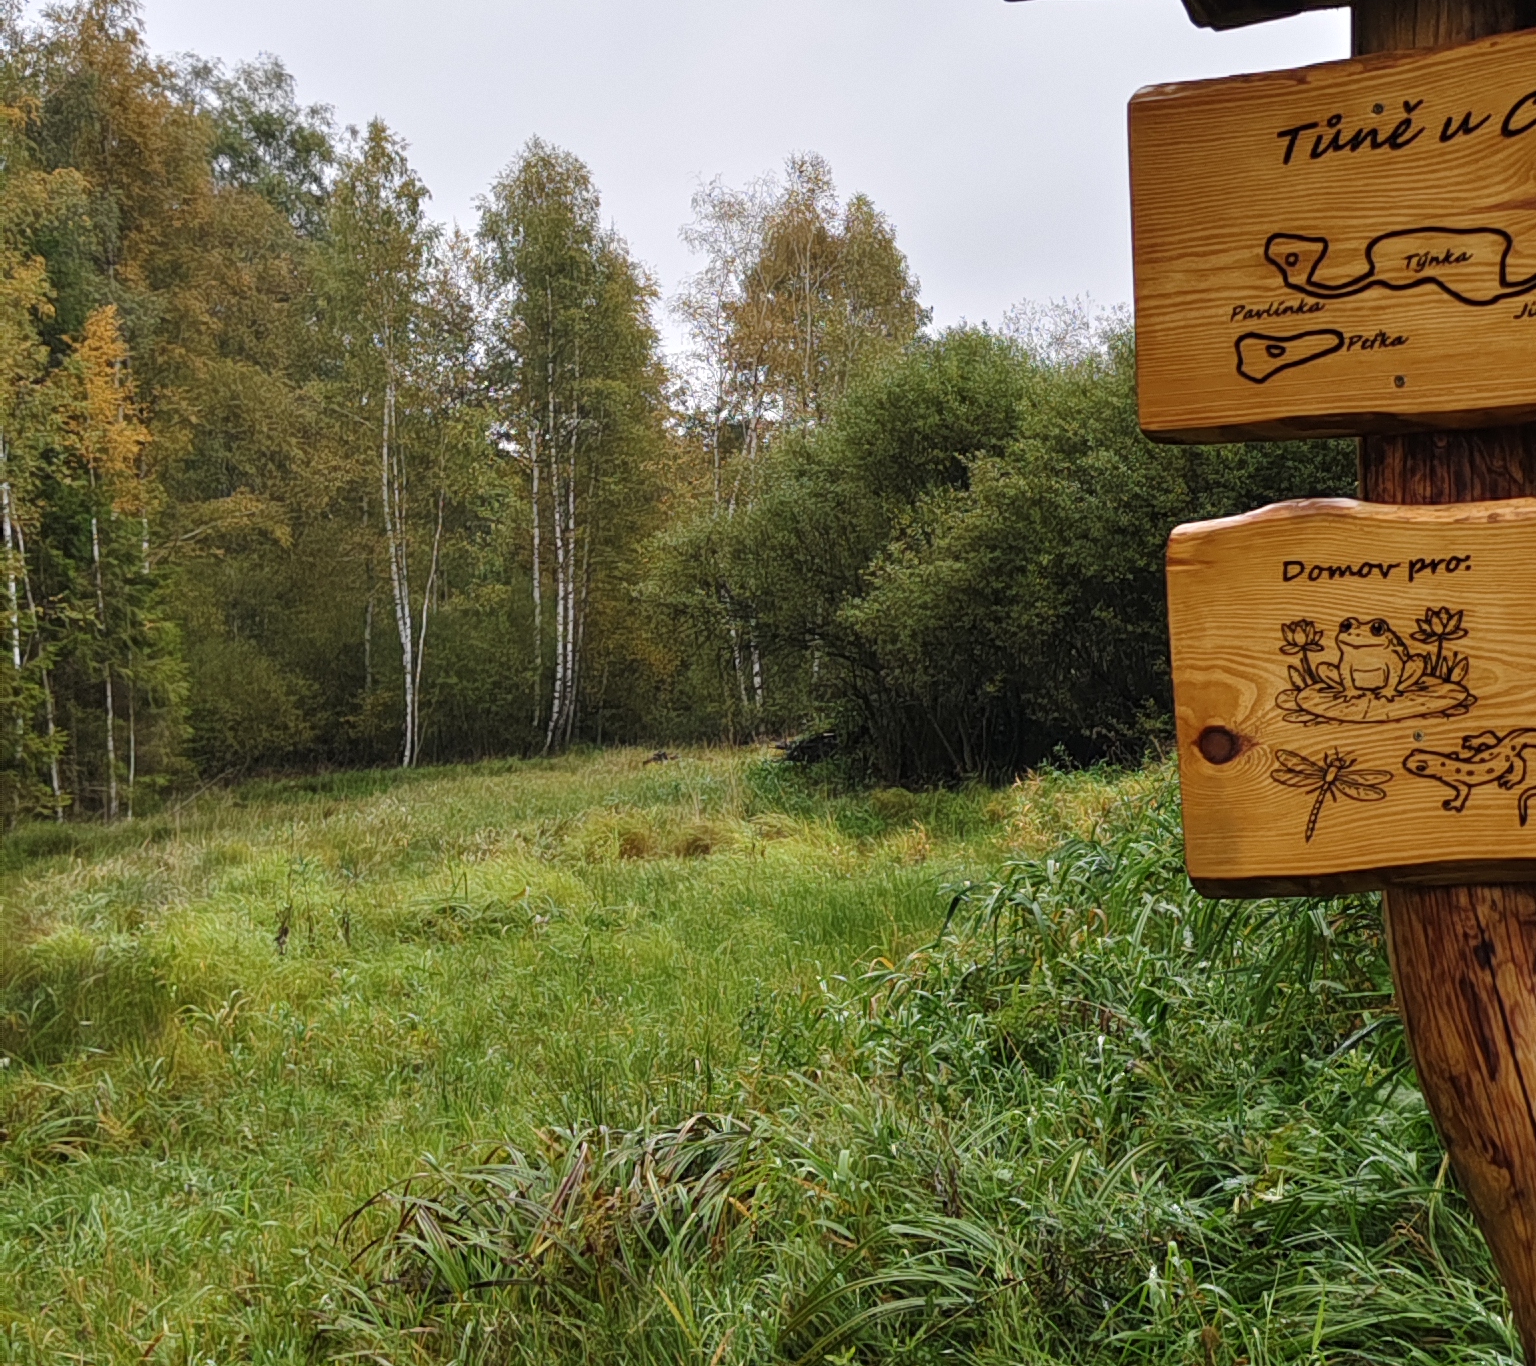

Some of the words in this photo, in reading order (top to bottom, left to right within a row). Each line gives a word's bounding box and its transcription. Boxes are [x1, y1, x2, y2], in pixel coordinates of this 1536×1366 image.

[1276, 98, 1426, 164] Tůně
[1438, 111, 1492, 143] u
[1403, 248, 1474, 274] Týnka
[1230, 298, 1326, 322] Pavlínka
[1282, 560, 1402, 582] Domov
[1408, 554, 1472, 583] pro:
